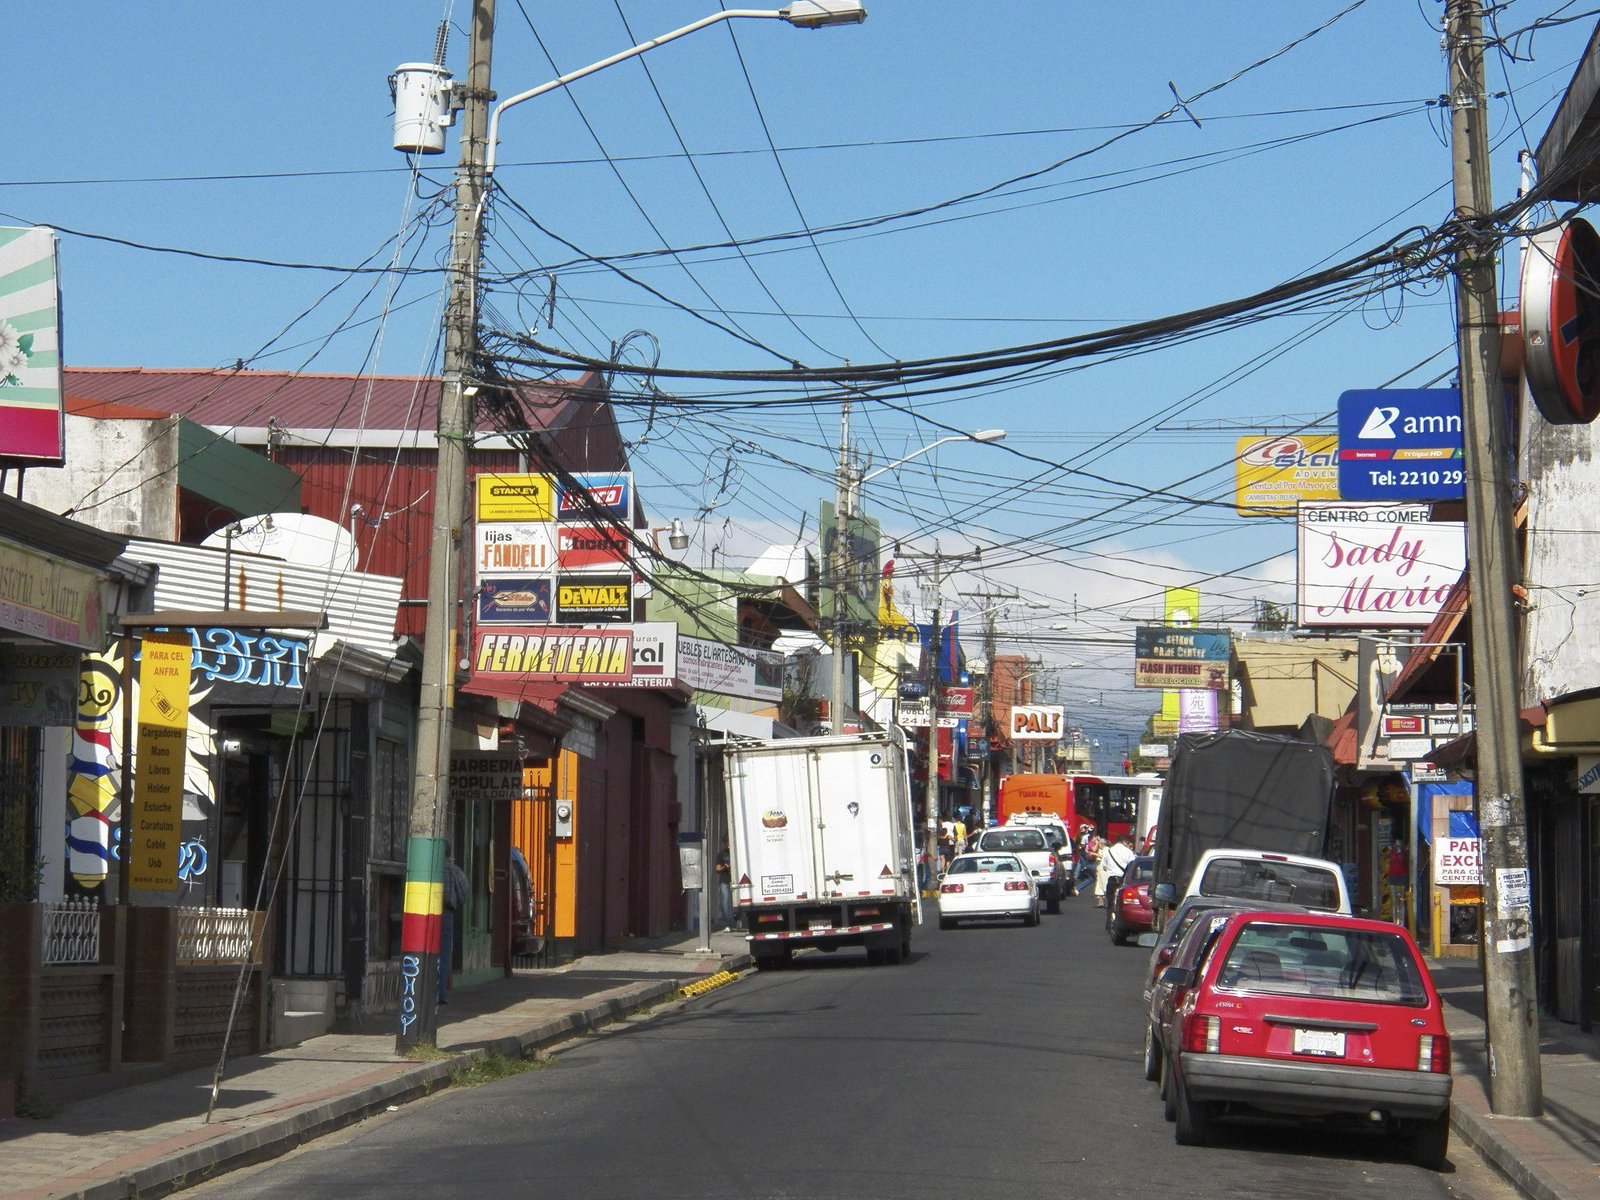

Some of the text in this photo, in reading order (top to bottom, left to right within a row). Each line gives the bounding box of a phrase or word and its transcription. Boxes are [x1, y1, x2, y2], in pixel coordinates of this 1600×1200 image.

[1369, 470, 1397, 486] Tel:
[1400, 471, 1440, 485] 2210
[493, 487, 536, 496] STANLEY
[1283, 481, 1297, 490] Por
[1298, 482, 1322, 492] Mayor
[1308, 511, 1430, 522] CENTRO COMER
[485, 530, 513, 544] lijas
[483, 544, 546, 567] FANDELI
[1322, 526, 1425, 577] Sady
[149, 651, 185, 662] PARA CEL
[477, 634, 627, 674] FERRETERIA
[154, 667, 180, 677] ANFRA
[1140, 663, 1202, 675] FLASH INTERNET
[923, 718, 956, 726] HS.
[141, 727, 182, 739] Cargadores
[151, 745, 170, 757] Mano
[149, 764, 171, 776] Libres
[449, 758, 522, 773] BARBERIA
[449, 775, 521, 789] POPULAR
[147, 783, 170, 794] Holder
[144, 802, 172, 813] Estuche
[140, 820, 174, 832] Caratulas
[146, 839, 167, 850] Cable
[148, 858, 162, 869] Usb
